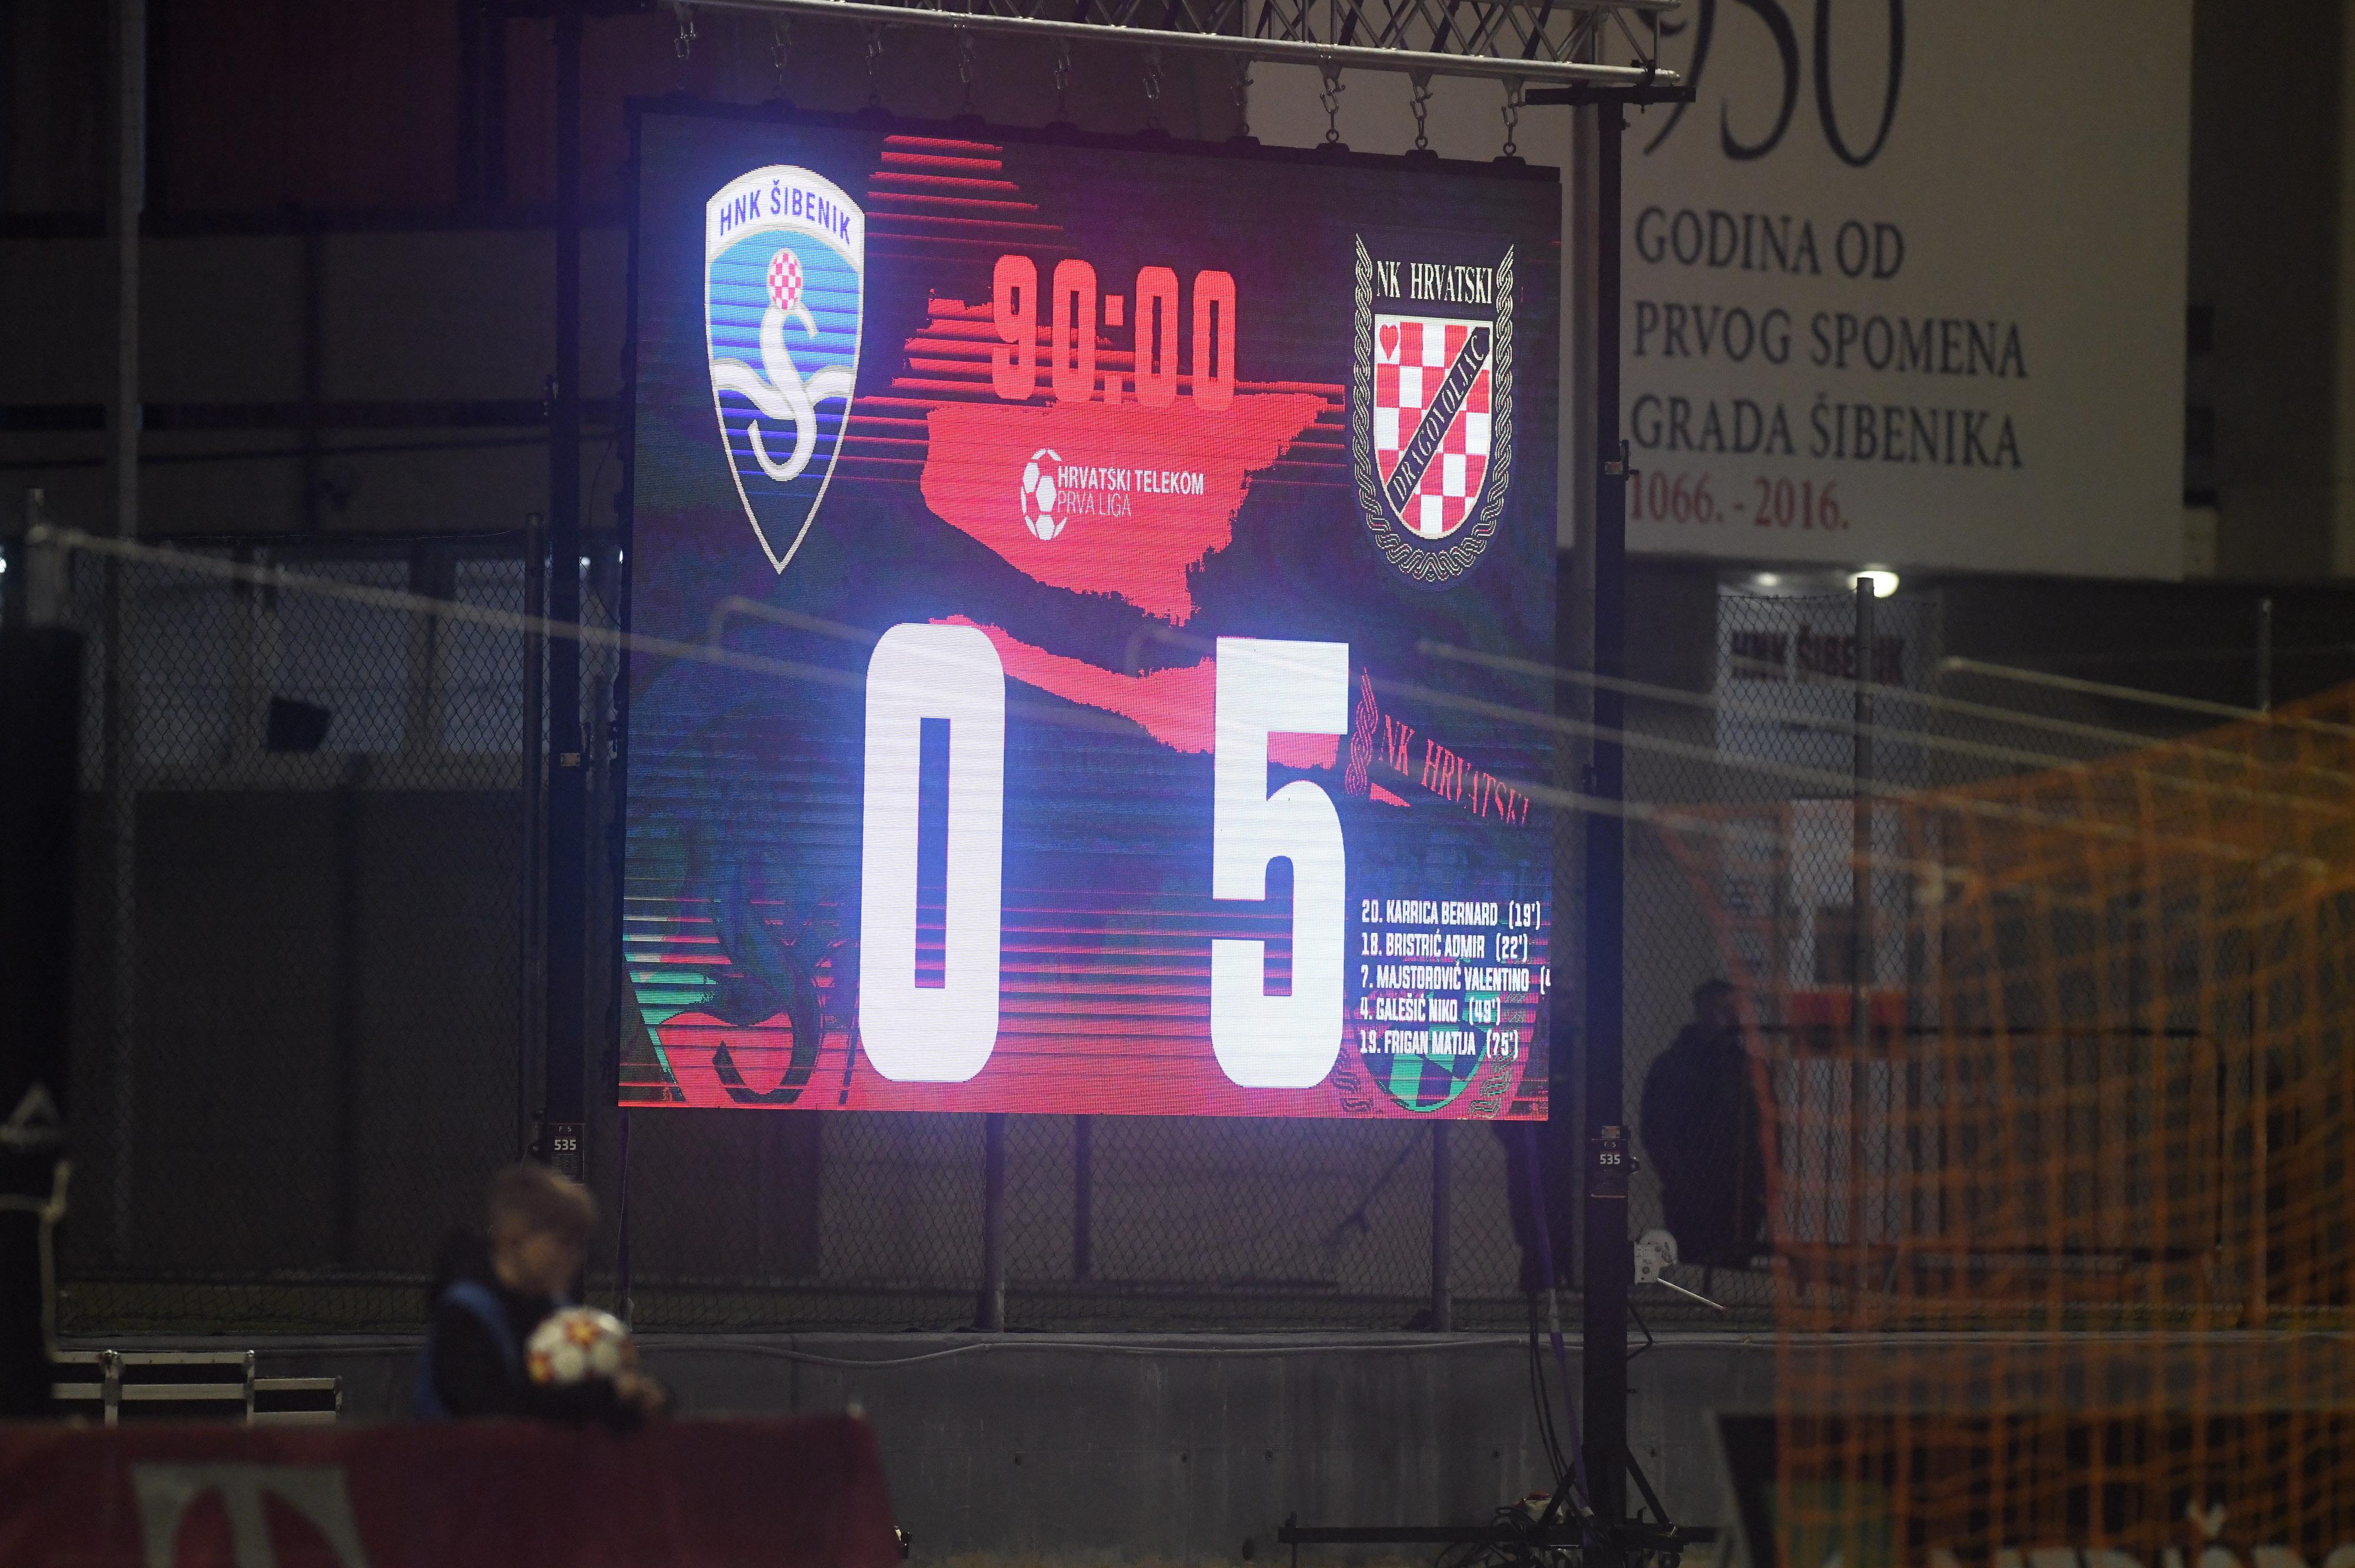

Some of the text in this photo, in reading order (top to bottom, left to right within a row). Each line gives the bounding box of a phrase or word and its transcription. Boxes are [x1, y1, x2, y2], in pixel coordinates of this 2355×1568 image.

[720, 179, 851, 245] HNK ŠIBENIK
[1634, 205, 1906, 280] GODINA OD
[1376, 261, 1494, 305] NK HRVATSKI
[992, 255, 1236, 411] 90:00
[1633, 300, 2029, 380] PRVOG SPOMENA
[1392, 334, 1485, 501] DRAGOVOLJAC
[1631, 393, 2024, 470] GRADA ŠIBENIKA
[1058, 466, 1205, 496] HRVATSKI TELEKOM
[1058, 491, 1132, 517] PRVA LIGA
[1378, 715, 1529, 825] NK HRVATSKI
[858, 622, 1006, 1082] 0
[1210, 637, 1349, 1088] 5
[1361, 899, 1541, 930] 20. KARRICA BERNARD (19')
[1361, 928, 1528, 962] 18. BRISTRIĆ ADMIR (22')
[1361, 964, 1374, 988] 7.
[1376, 961, 1461, 990] MAJSTOROVIĆ
[1464, 966, 1530, 991] VALENTINO
[1360, 996, 1373, 1020] 4.
[1376, 992, 1425, 1022] GALEŠIĆ
[1428, 998, 1458, 1022] NIKO
[1360, 1029, 1381, 1054] 19.
[1384, 1030, 1428, 1054] FRIGAN
[1431, 1031, 1476, 1055] MATIJA
[554, 1139, 576, 1151] 535
[1600, 1154, 1621, 1165] 535
